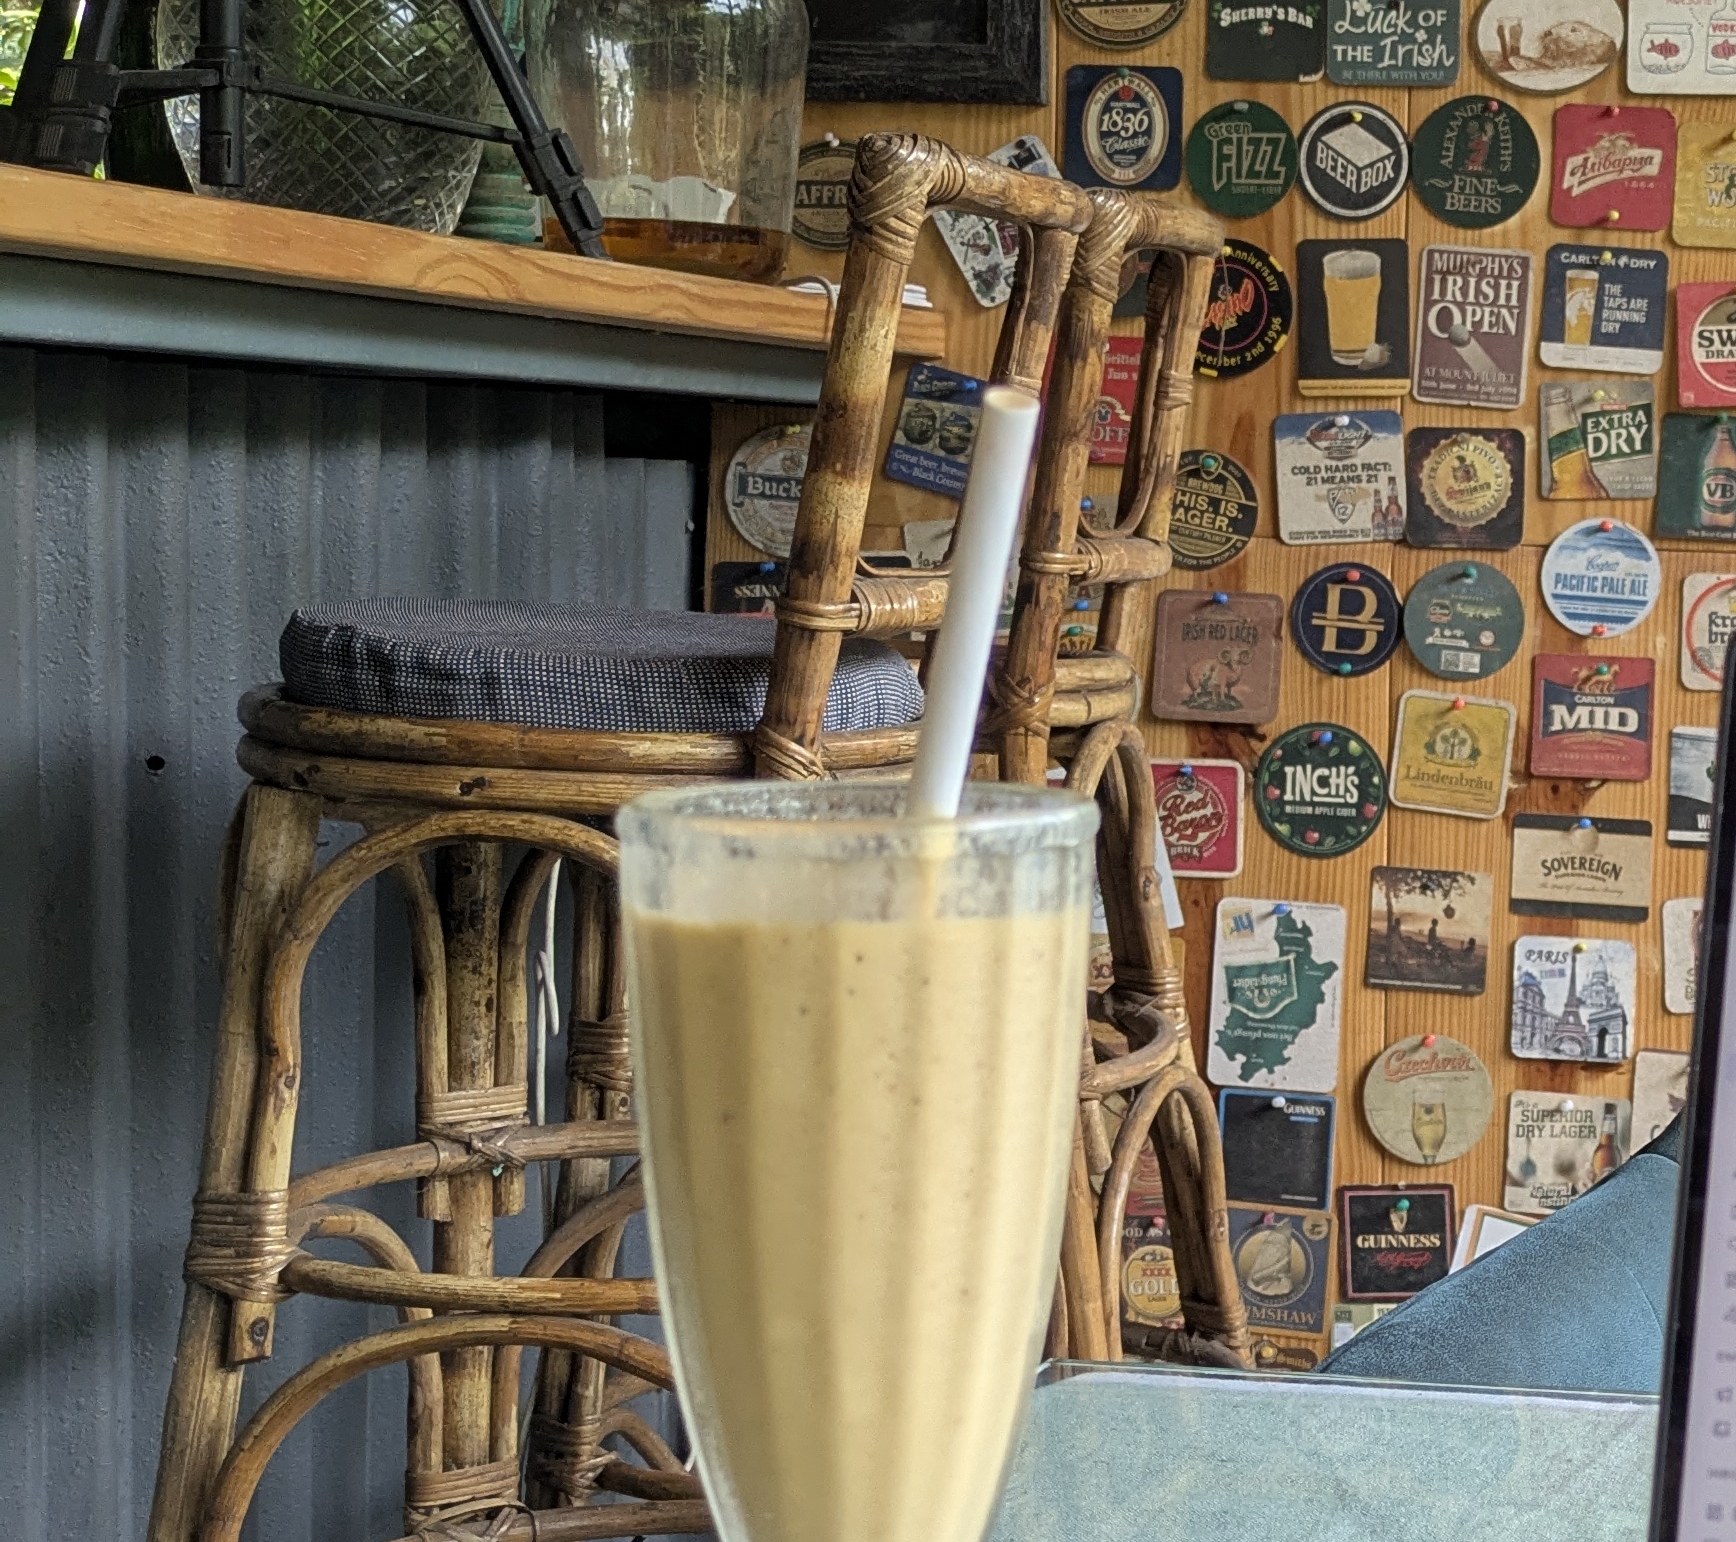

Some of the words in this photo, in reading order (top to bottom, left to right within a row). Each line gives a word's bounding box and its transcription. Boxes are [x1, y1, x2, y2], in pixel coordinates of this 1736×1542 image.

[1417, 10, 1447, 26] OF
[1333, 45, 1372, 62] THE
[1377, 31, 1455, 68] Irish
[1100, 107, 1149, 134] 1836
[1204, 122, 1252, 140] Green
[1101, 134, 1151, 153] Classic
[1212, 132, 1288, 191] FIZZ
[1316, 141, 1358, 194] BEER
[1360, 154, 1395, 192] BOX
[1452, 176, 1499, 194] FINE
[1445, 194, 1501, 214] BEERS
[1630, 259, 1656, 270] DRY
[1432, 275, 1521, 305] IRISH
[1604, 284, 1622, 296] THE
[1603, 297, 1627, 309] TAPS
[1629, 298, 1648, 310] ARE
[1428, 303, 1519, 338] OPEN
[1602, 309, 1646, 322] RUNNING
[1601, 321, 1620, 334] DRY
[1586, 410, 1647, 435] EXTRA
[1587, 424, 1649, 457] DRY
[1291, 464, 1321, 476] COLD
[1326, 463, 1357, 475] HARD
[1360, 462, 1392, 473] FACT:
[1305, 476, 1318, 485] 21
[1321, 475, 1362, 485] MEANS
[1365, 474, 1379, 483] 21
[1706, 483, 1734, 498] VB
[1219, 503, 1243, 519] IS.
[1554, 573, 1599, 593] PACIFIC
[1601, 575, 1626, 594] PALE
[1629, 577, 1648, 595] ALE
[1574, 695, 1614, 704] CARLTON
[1550, 704, 1639, 733] MID
[1405, 765, 1493, 792] Lindenbräu
[1541, 857, 1622, 882] SOVEREIGN
[1525, 949, 1568, 962] PARIS
[1284, 1103, 1326, 1117] GUINNESS
[1520, 1109, 1594, 1124] SUPERIOR
[1515, 1124, 1546, 1139] DRY
[1550, 1124, 1598, 1140] LAGER
[1356, 1233, 1441, 1249] GUINNESS
